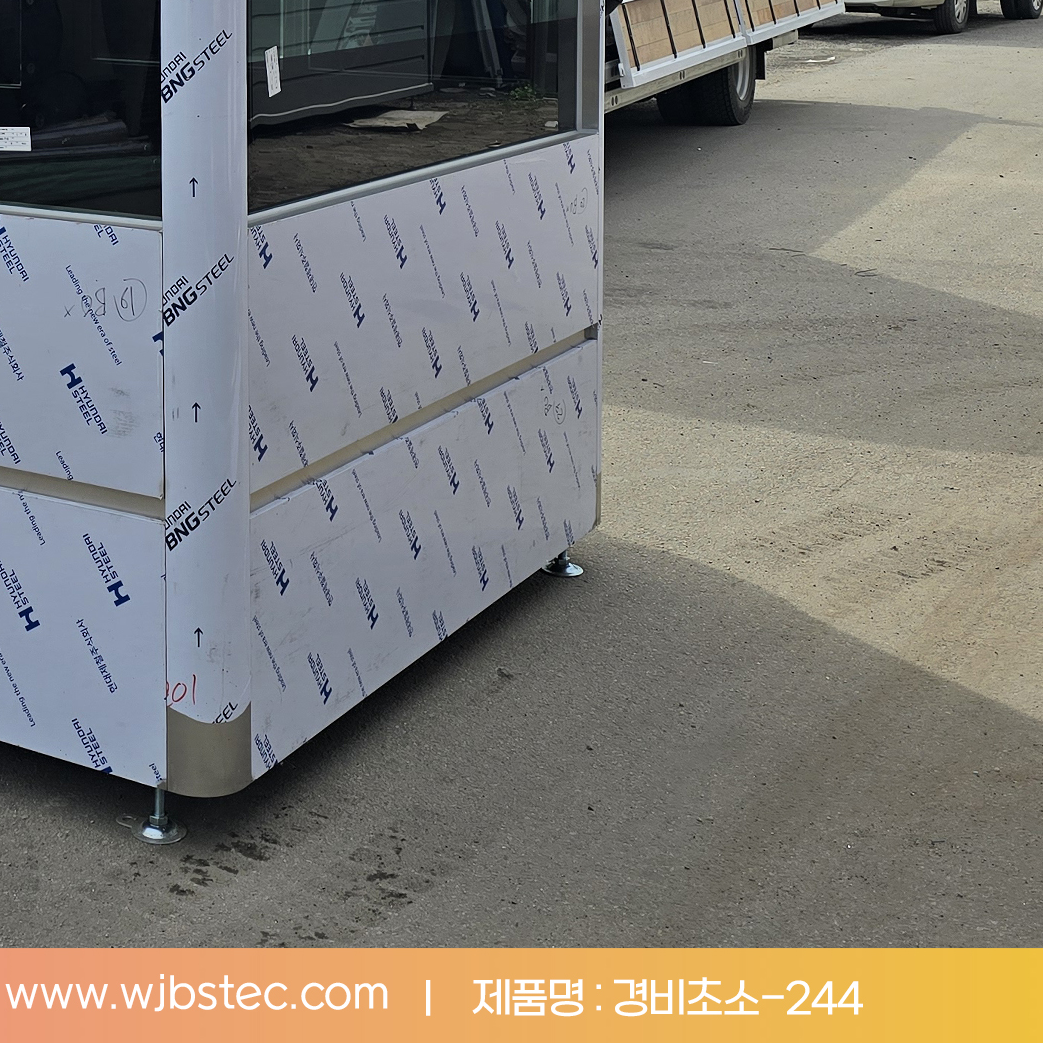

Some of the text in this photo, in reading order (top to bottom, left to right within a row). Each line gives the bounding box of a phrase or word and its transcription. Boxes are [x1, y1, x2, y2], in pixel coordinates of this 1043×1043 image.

[1, 235, 31, 283] HYUNDAI
[71, 389, 93, 427] STEEL
[77, 385, 109, 435] HYUNDAI
[81, 533, 112, 584] HYUNDAI
[97, 542, 119, 580] STEEL
[9, 569, 30, 606] STEEL
